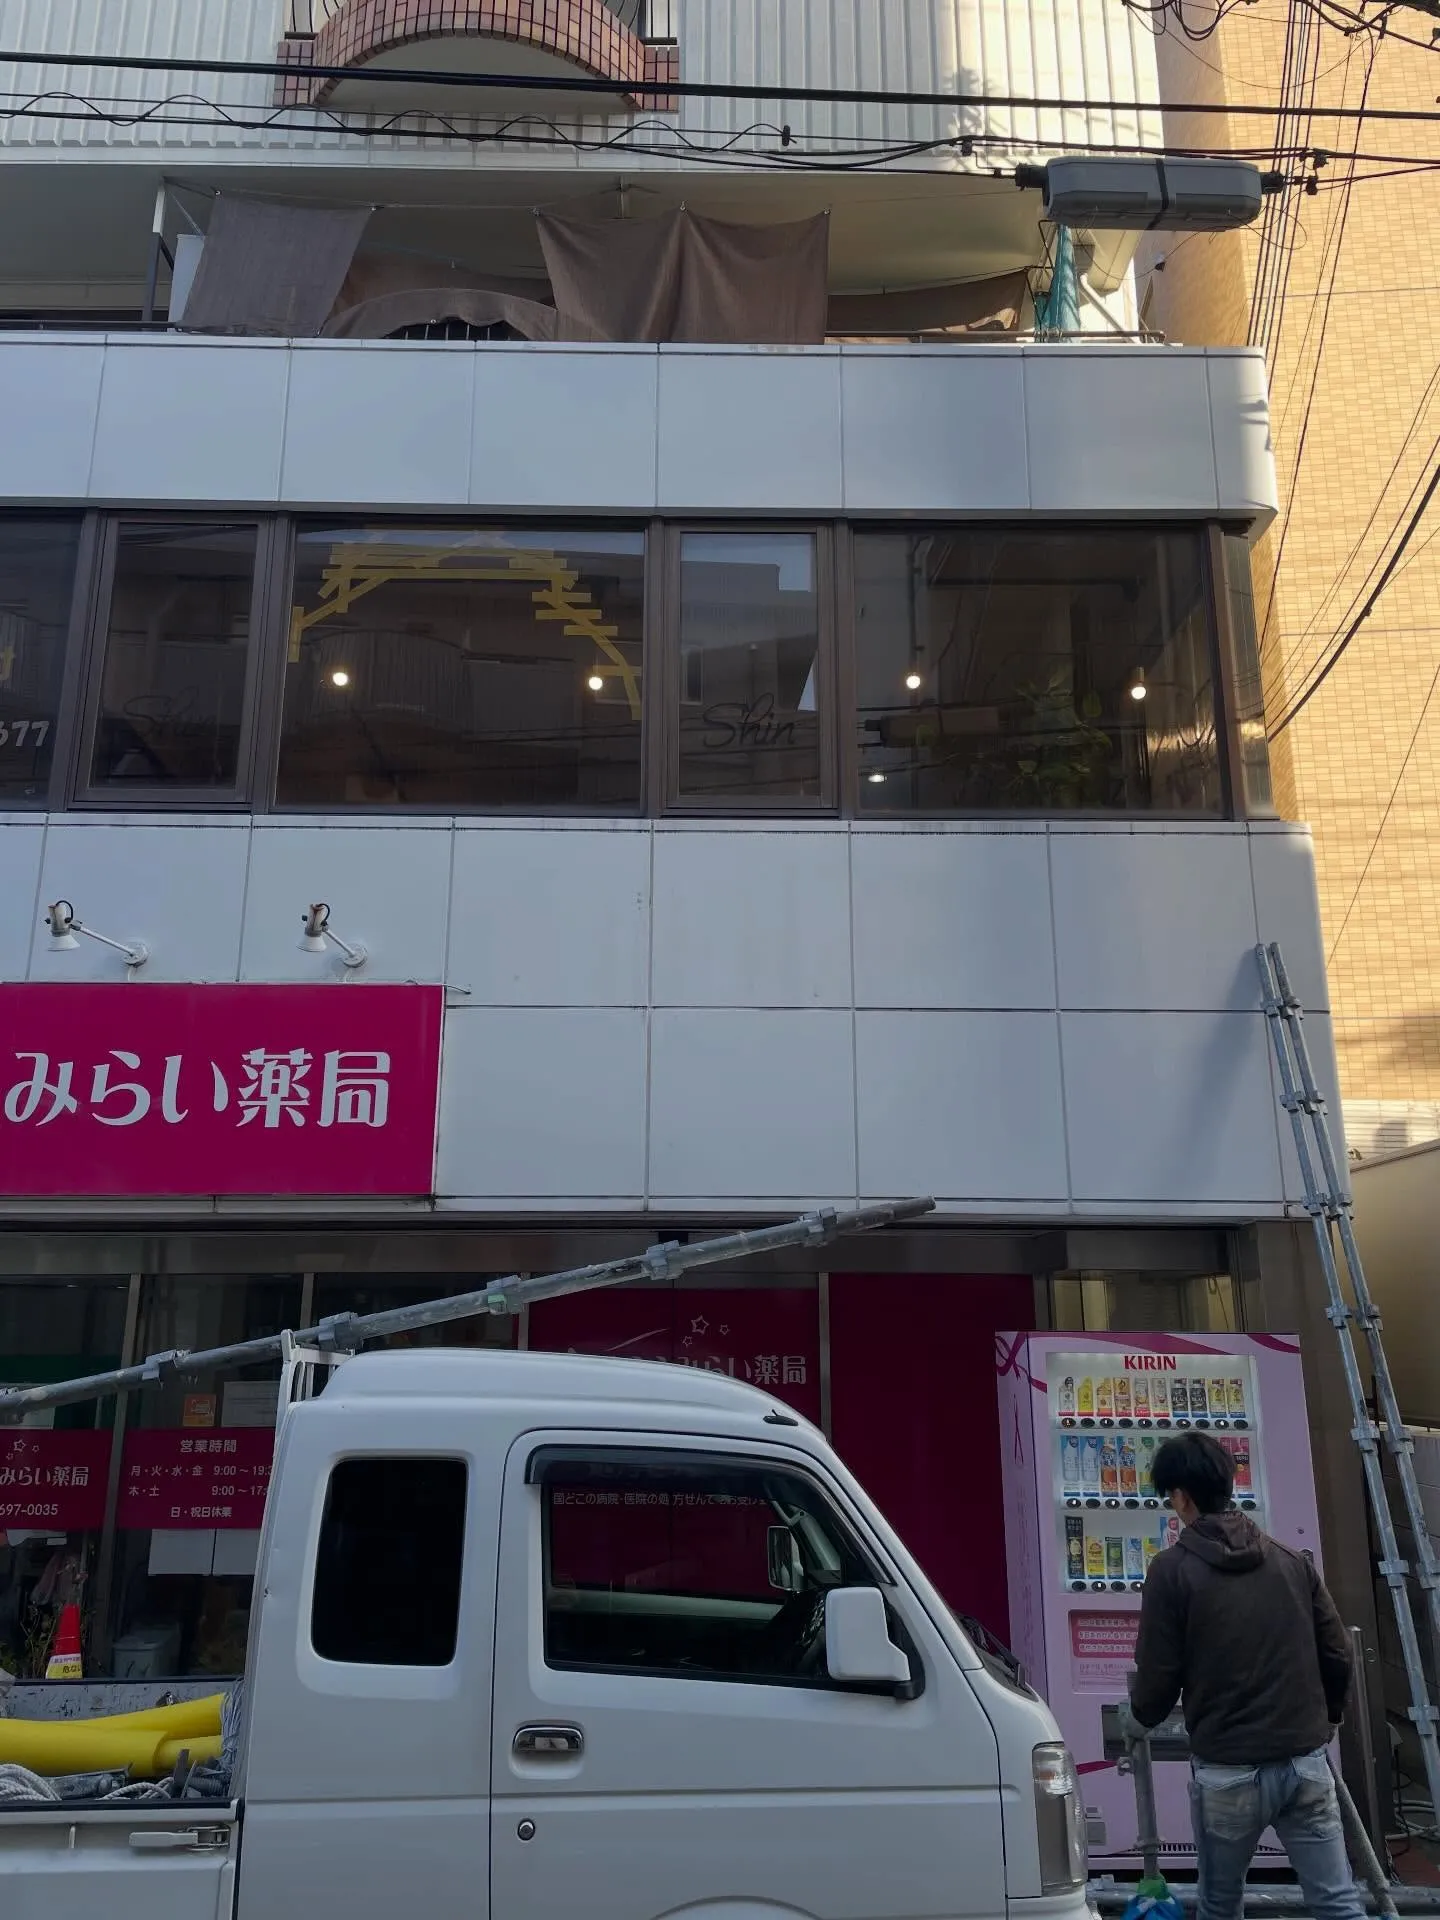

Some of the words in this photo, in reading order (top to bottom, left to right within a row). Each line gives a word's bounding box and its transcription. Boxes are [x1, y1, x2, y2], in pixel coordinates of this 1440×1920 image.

[703, 692, 800, 748] Shin
[4, 1047, 391, 1128] みらい薬局
[1124, 1355, 1177, 1371] KIRIN
[180, 1440, 237, 1453] 営業時間
[0, 1466, 89, 1486] みらい薬局
